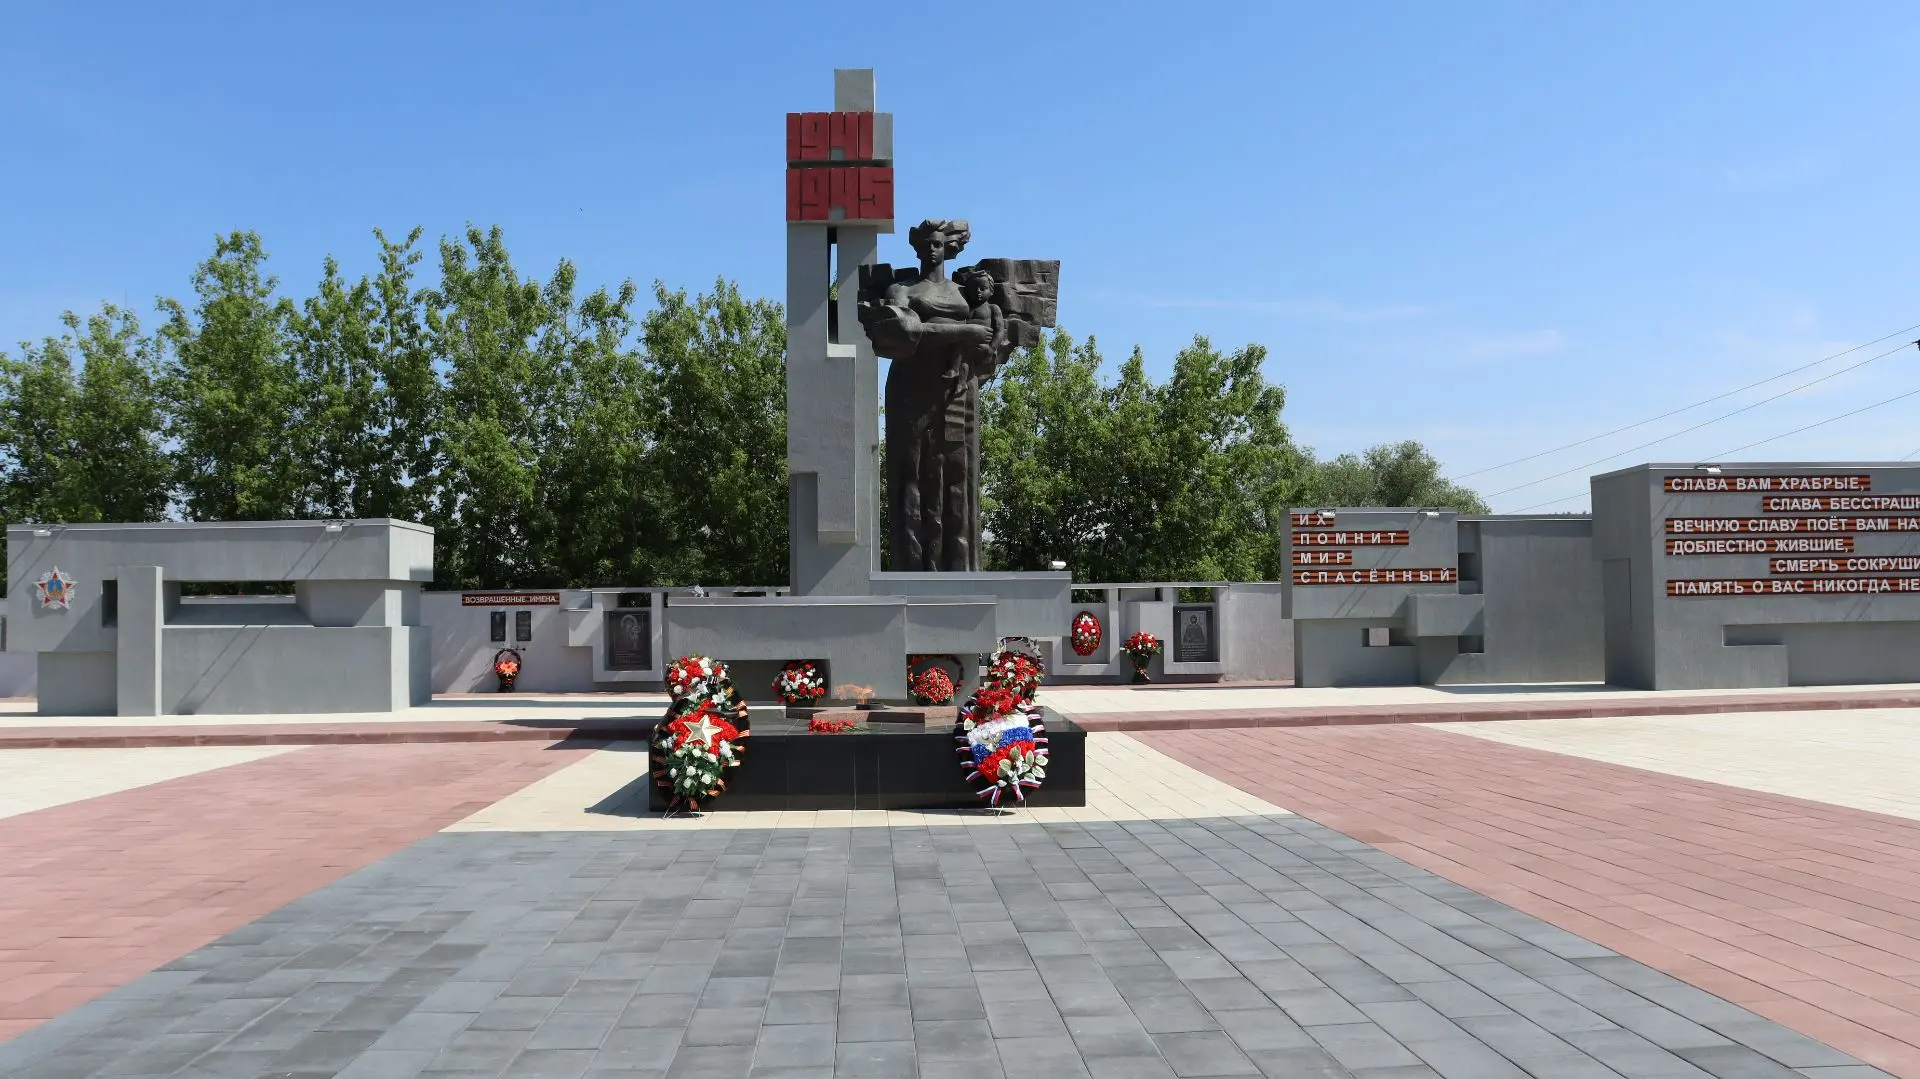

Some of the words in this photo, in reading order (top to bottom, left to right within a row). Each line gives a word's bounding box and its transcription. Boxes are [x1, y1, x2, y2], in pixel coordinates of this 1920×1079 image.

[786, 167, 894, 221] 1945
[1671, 477, 1729, 491] СЛАВА
[1736, 477, 1771, 491] ВАМ
[1779, 476, 1865, 492] ХРАБРЫЕ,
[1769, 497, 1822, 511] СЛАВА
[1300, 514, 1326, 526] ИХ
[1673, 519, 1740, 533] ВЕЧНУЮ
[1748, 518, 1799, 532] СЛАВУ
[1807, 515, 1848, 532] ПОЁТ
[1856, 518, 1889, 531] ВАМ
[1300, 532, 1397, 545] ПОМНИТ
[1672, 539, 1767, 556] ДОБЛЕСТНО
[1775, 538, 1849, 553] ЖИВШИЕ,
[1300, 552, 1346, 564] МИР
[1775, 558, 1839, 572] СМЕРТЬ
[1300, 568, 1450, 583] СПАСЁННЫЙ
[1675, 581, 1744, 595] ПАМЯТЬ
[1752, 580, 1764, 593] О
[1772, 580, 1805, 593] ВАС
[1813, 579, 1891, 594] НИКОГДА
[1899, 578, 1920, 591] НЕ
[529, 595, 556, 603] ИМЕНА
